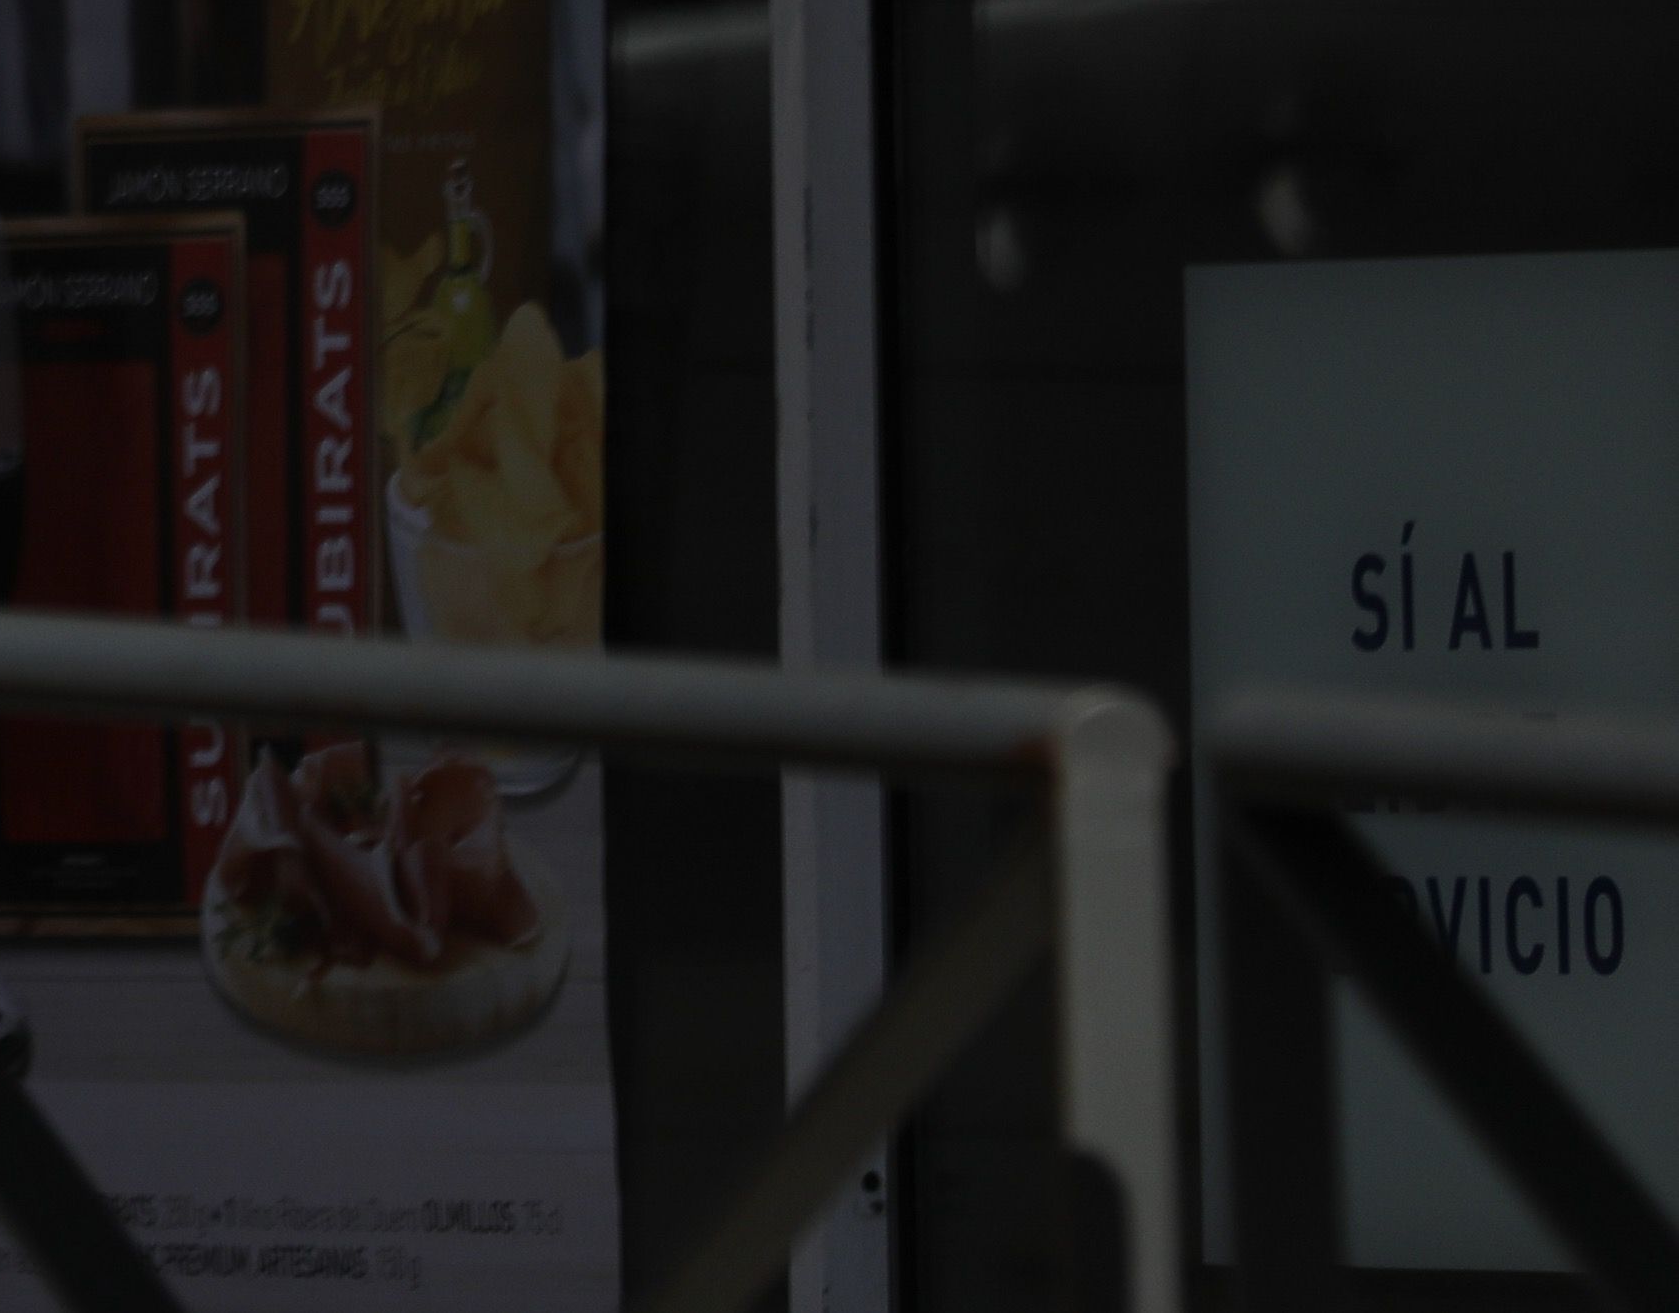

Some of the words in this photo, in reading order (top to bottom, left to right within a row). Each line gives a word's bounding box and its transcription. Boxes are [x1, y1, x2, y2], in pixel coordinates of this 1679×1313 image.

[185, 163, 289, 203] SERRANO
[313, 259, 356, 637] UBIRATS
[183, 365, 229, 828] SUIRATS
[1350, 521, 1417, 652] SÍ
[1448, 551, 1540, 651] AL
[1379, 874, 1625, 977] VICIO
